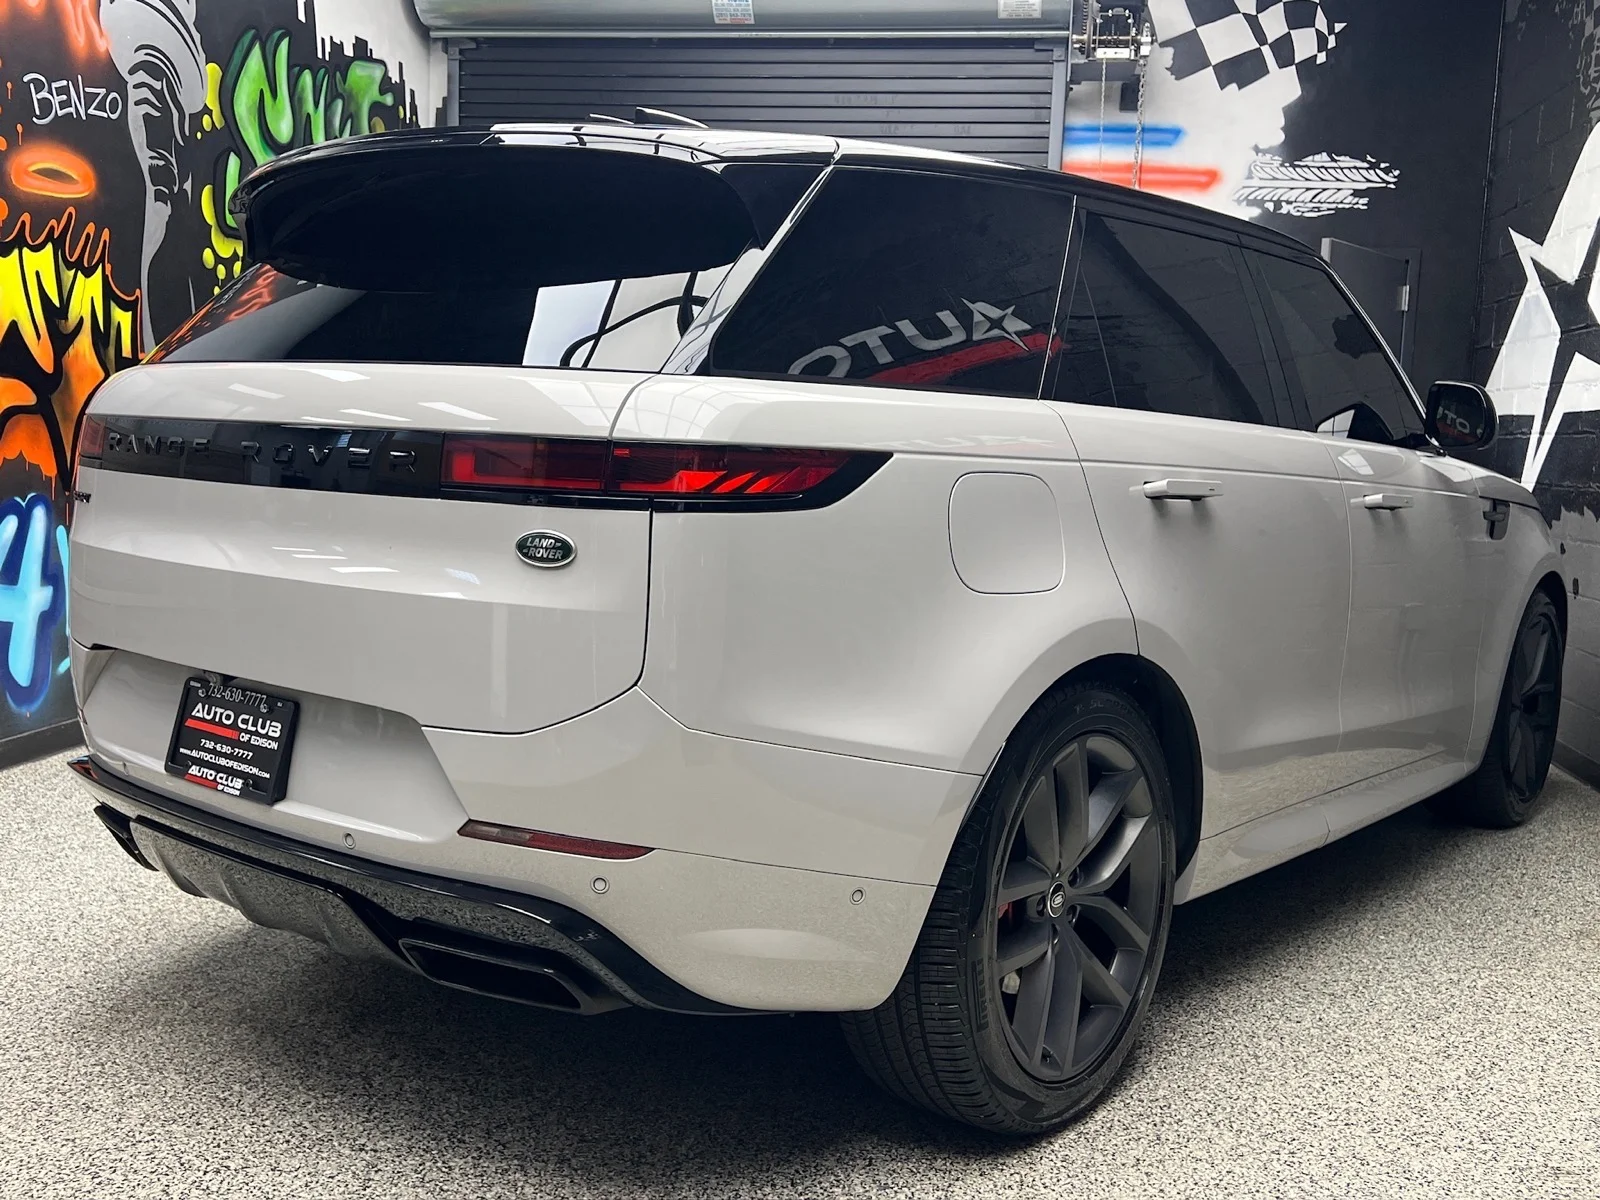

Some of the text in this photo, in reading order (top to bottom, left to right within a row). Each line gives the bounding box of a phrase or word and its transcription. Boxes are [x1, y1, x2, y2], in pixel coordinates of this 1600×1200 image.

[23, 73, 122, 125] BENZO
[108, 432, 417, 473] RANGE ROVER
[526, 537, 563, 559] LAND ROVER
[208, 683, 267, 707] 732-630-7777
[191, 702, 282, 738] AUTO CLUB
[200, 739, 253, 760] 732-630-7777
[240, 733, 279, 750] OF EDISON
[188, 765, 244, 790] AUTO CLUB
